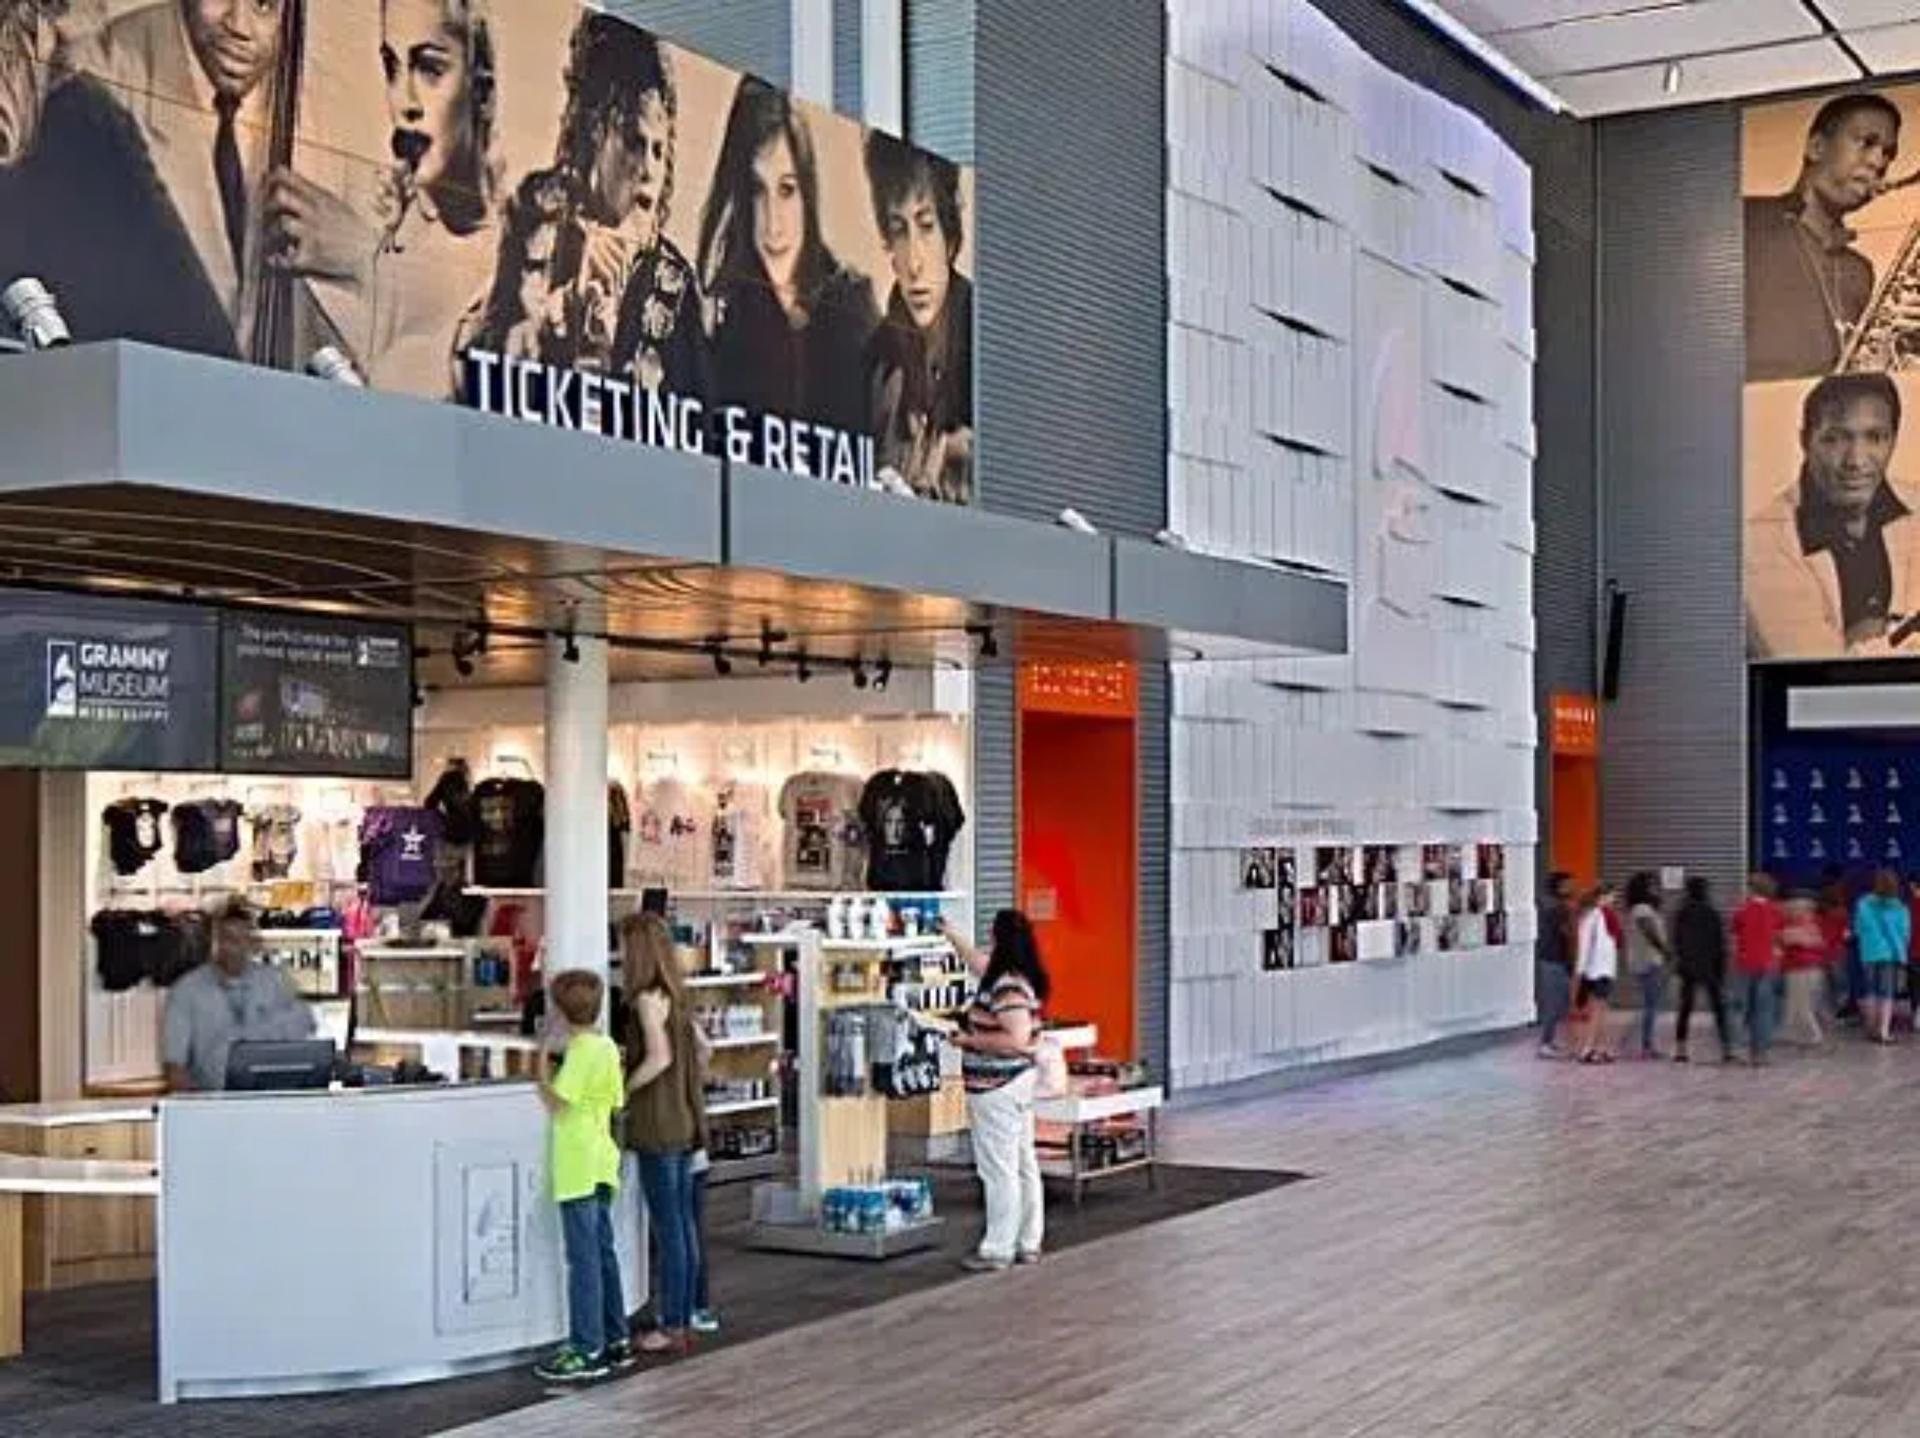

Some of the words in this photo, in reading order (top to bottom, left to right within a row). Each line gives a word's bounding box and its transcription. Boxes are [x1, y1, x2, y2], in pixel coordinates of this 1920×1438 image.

[468, 348, 704, 456] TICKETING
[726, 406, 754, 462] &
[764, 414, 884, 490] RETAIL
[81, 644, 169, 671] GRAMMY
[79, 671, 169, 698] MUSEUM
